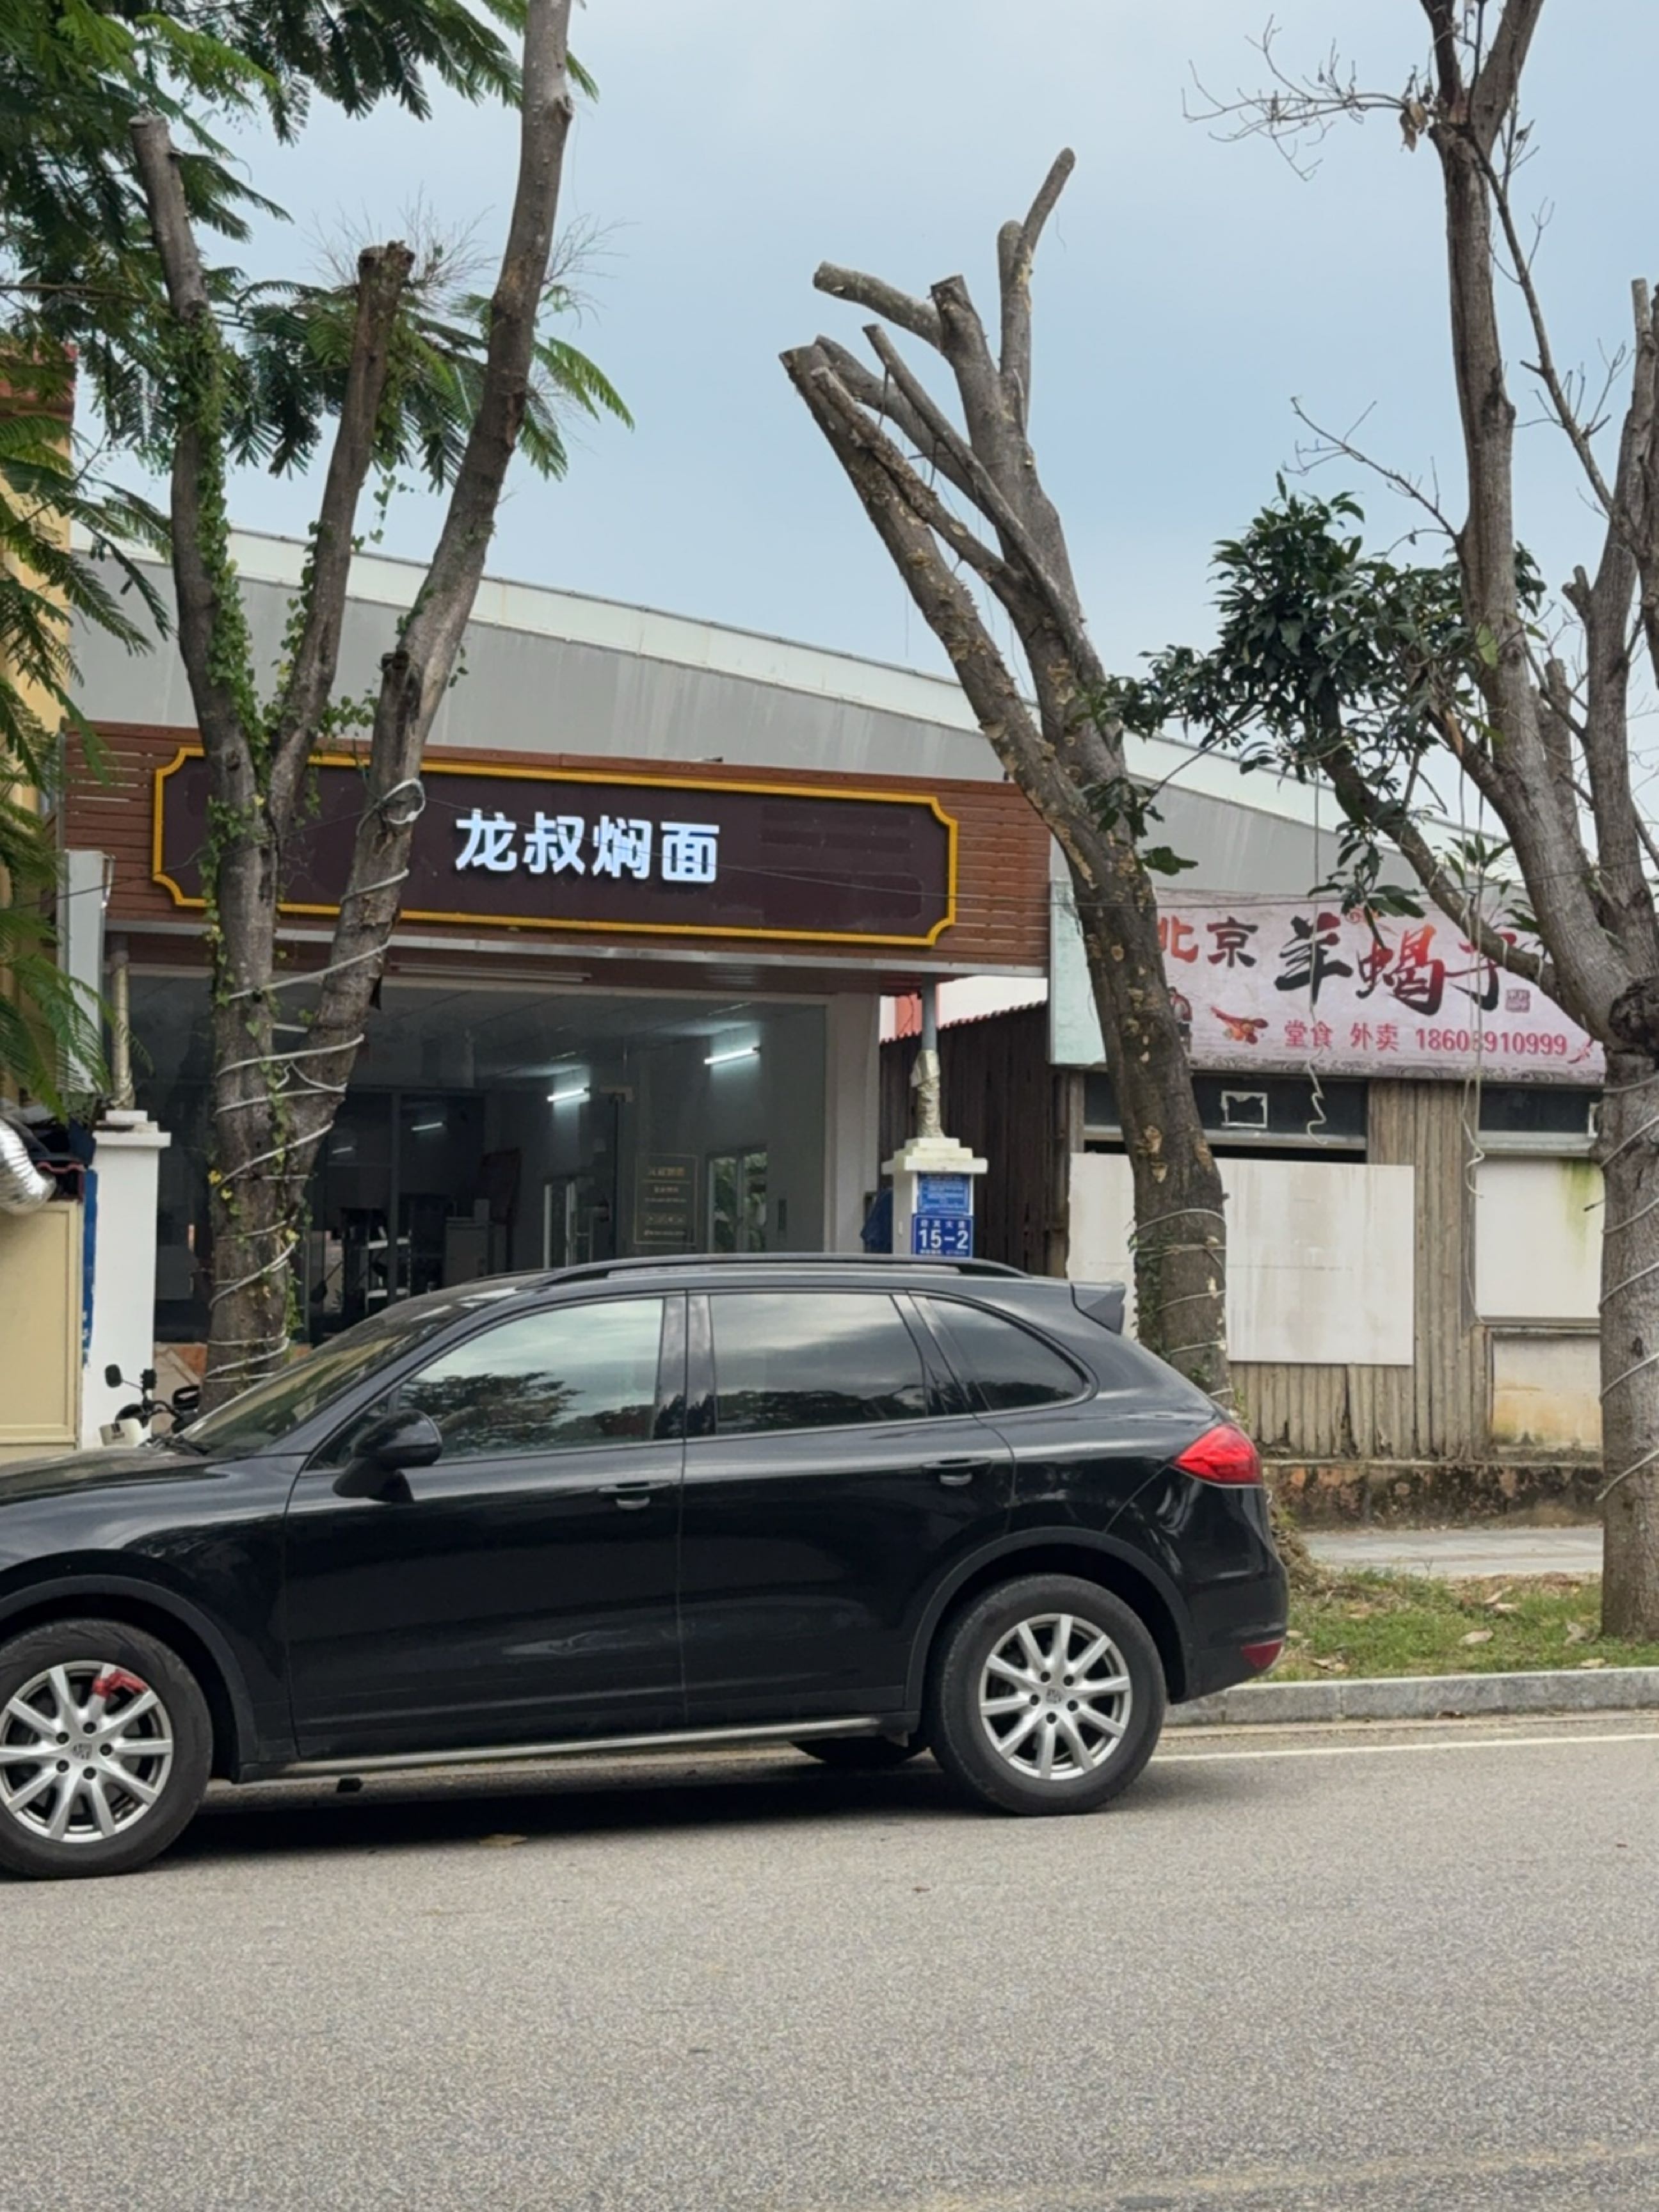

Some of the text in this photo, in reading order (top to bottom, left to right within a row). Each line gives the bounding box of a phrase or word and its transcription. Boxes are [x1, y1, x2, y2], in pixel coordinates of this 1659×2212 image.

[455, 808, 720, 882] 龙叔焖面
[1285, 1020, 1333, 1051] 堂食
[1349, 1022, 1399, 1052] 外卖
[918, 1229, 968, 1249] 15-2
